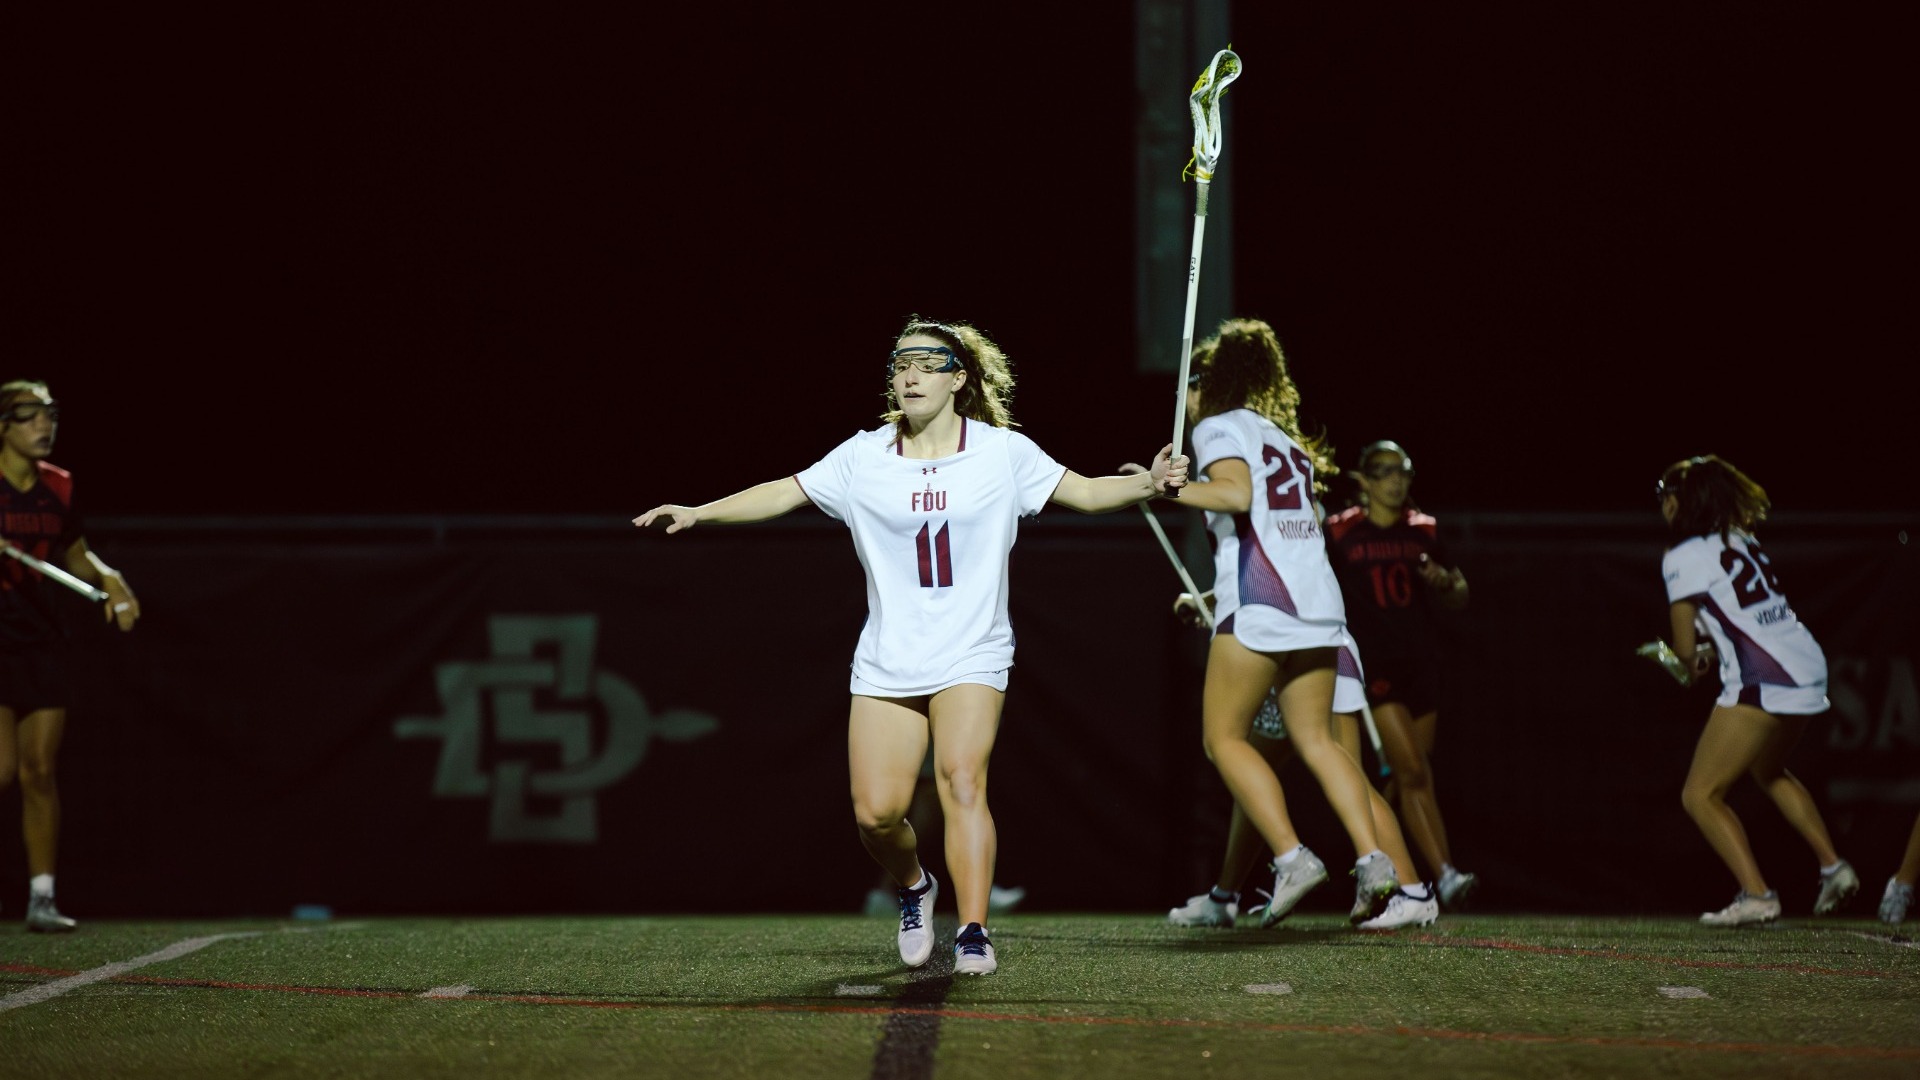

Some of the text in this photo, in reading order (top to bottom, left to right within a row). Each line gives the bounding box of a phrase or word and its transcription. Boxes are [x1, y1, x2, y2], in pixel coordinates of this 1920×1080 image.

[911, 490, 947, 512] FDU
[915, 519, 954, 588] 11
[1370, 562, 1412, 610] 10
